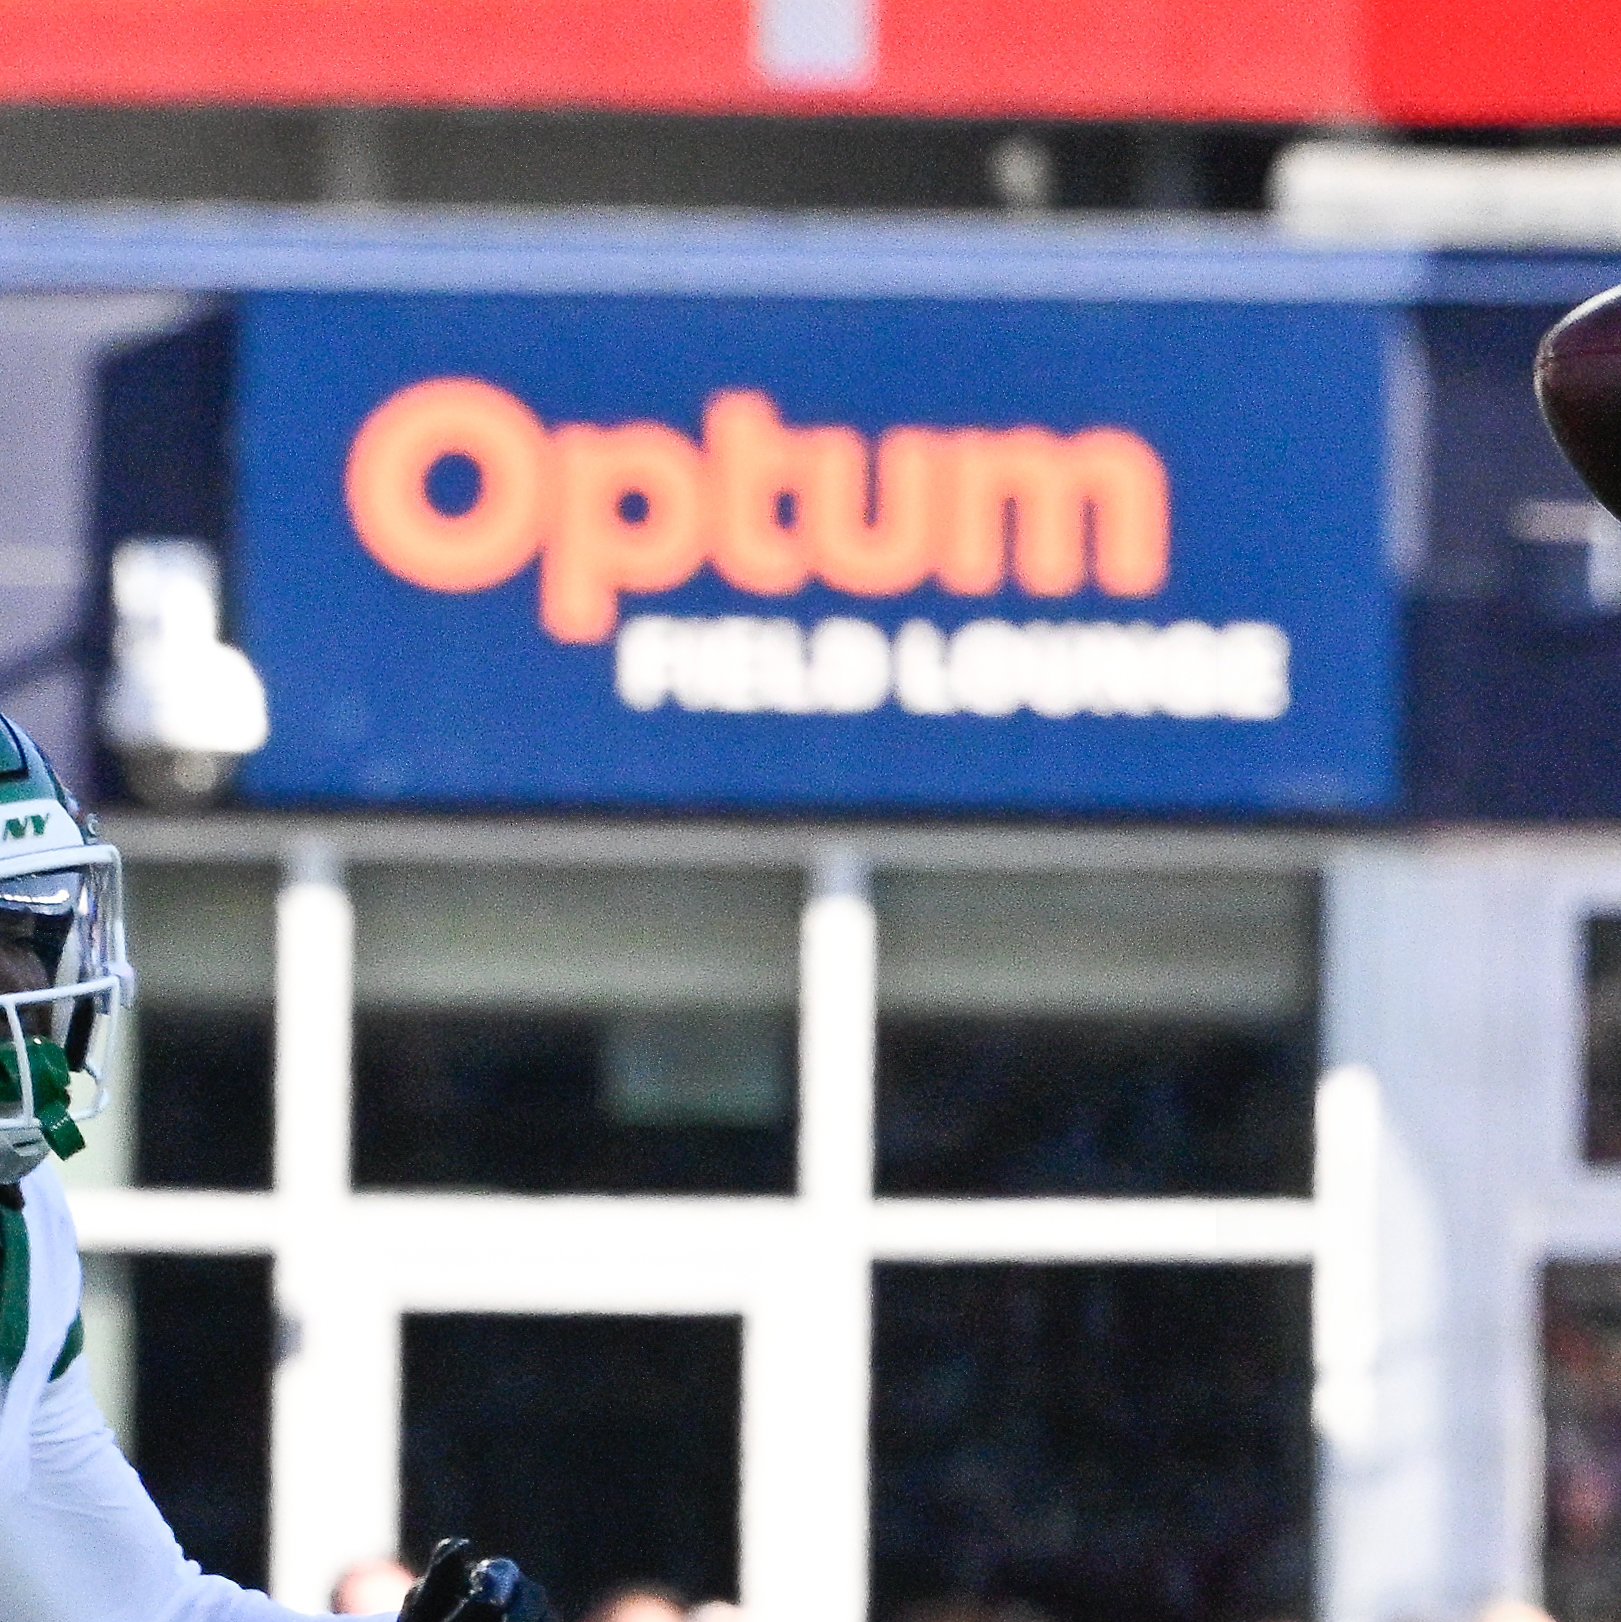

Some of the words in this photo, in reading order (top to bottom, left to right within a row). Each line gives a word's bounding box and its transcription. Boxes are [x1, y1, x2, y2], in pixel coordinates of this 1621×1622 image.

[346, 376, 1168, 642] Optum
[616, 615, 891, 711] FIELD
[895, 618, 1289, 718] LOUNGE
[3, 813, 50, 841] NY
